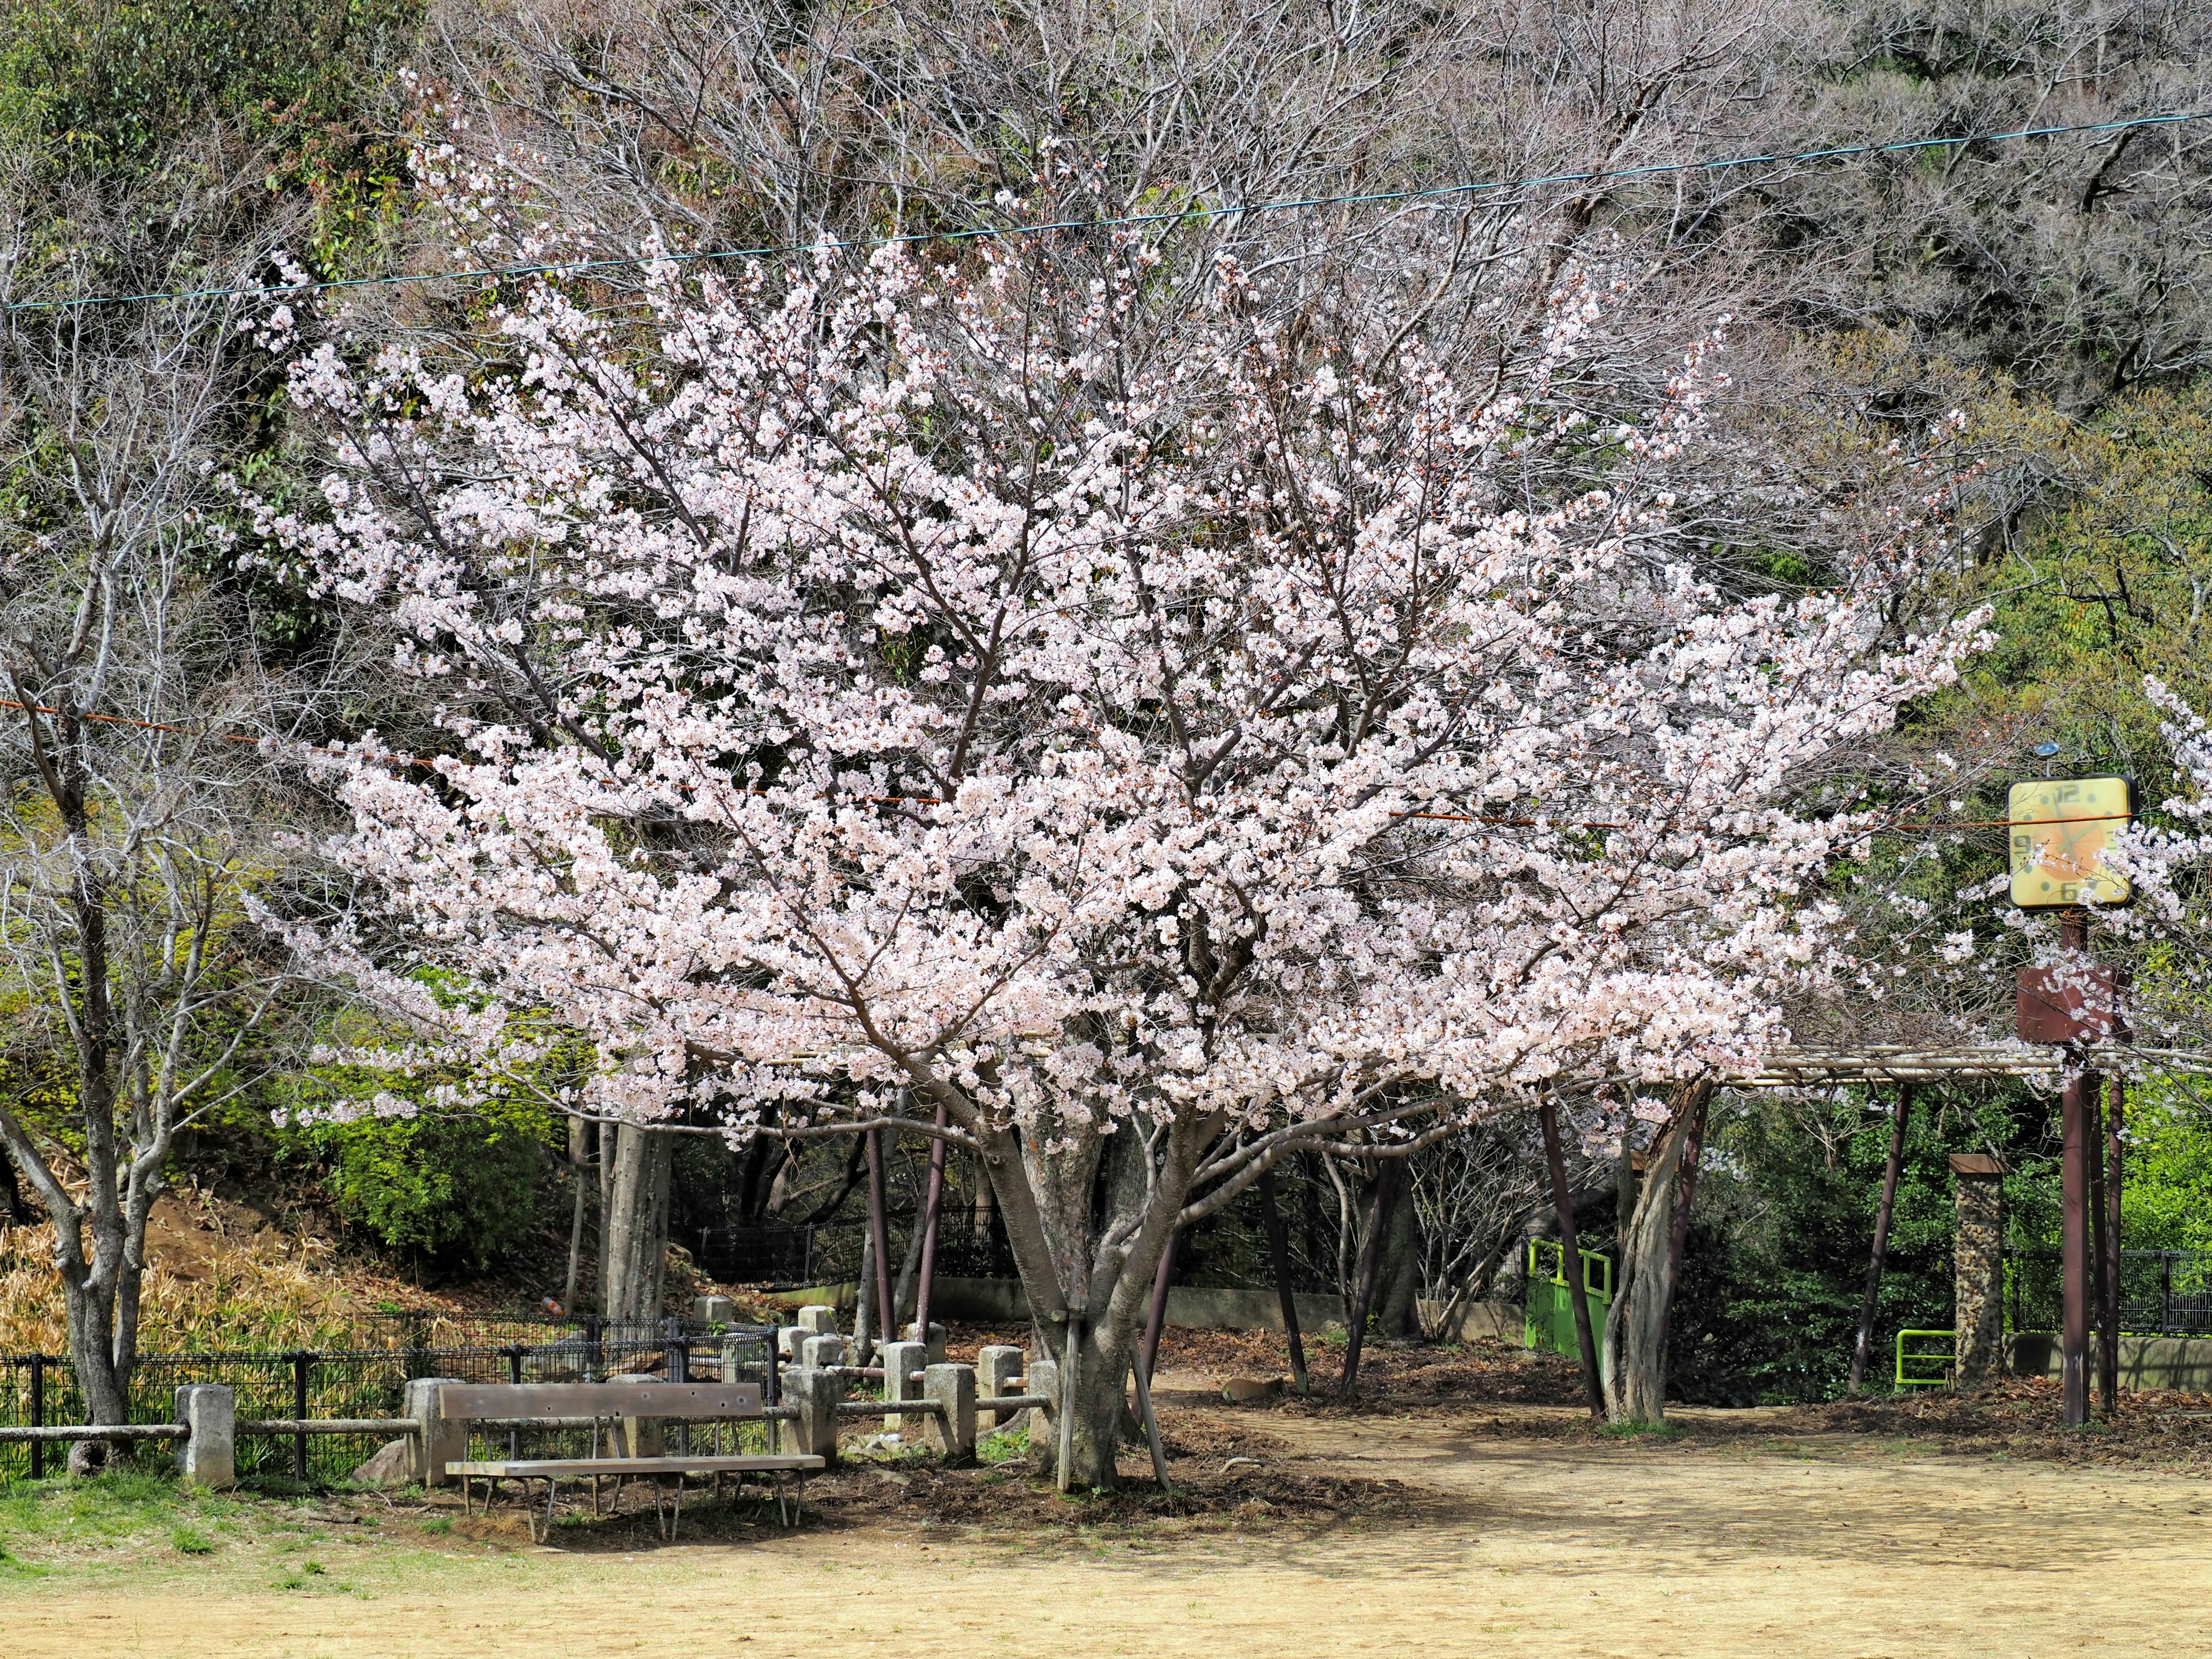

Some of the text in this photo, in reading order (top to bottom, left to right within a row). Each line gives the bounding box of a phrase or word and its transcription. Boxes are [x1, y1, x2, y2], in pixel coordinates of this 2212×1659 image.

[2055, 785, 2080, 802] 12
[2014, 835, 2031, 854] 9
[2061, 882, 2078, 901] 6
